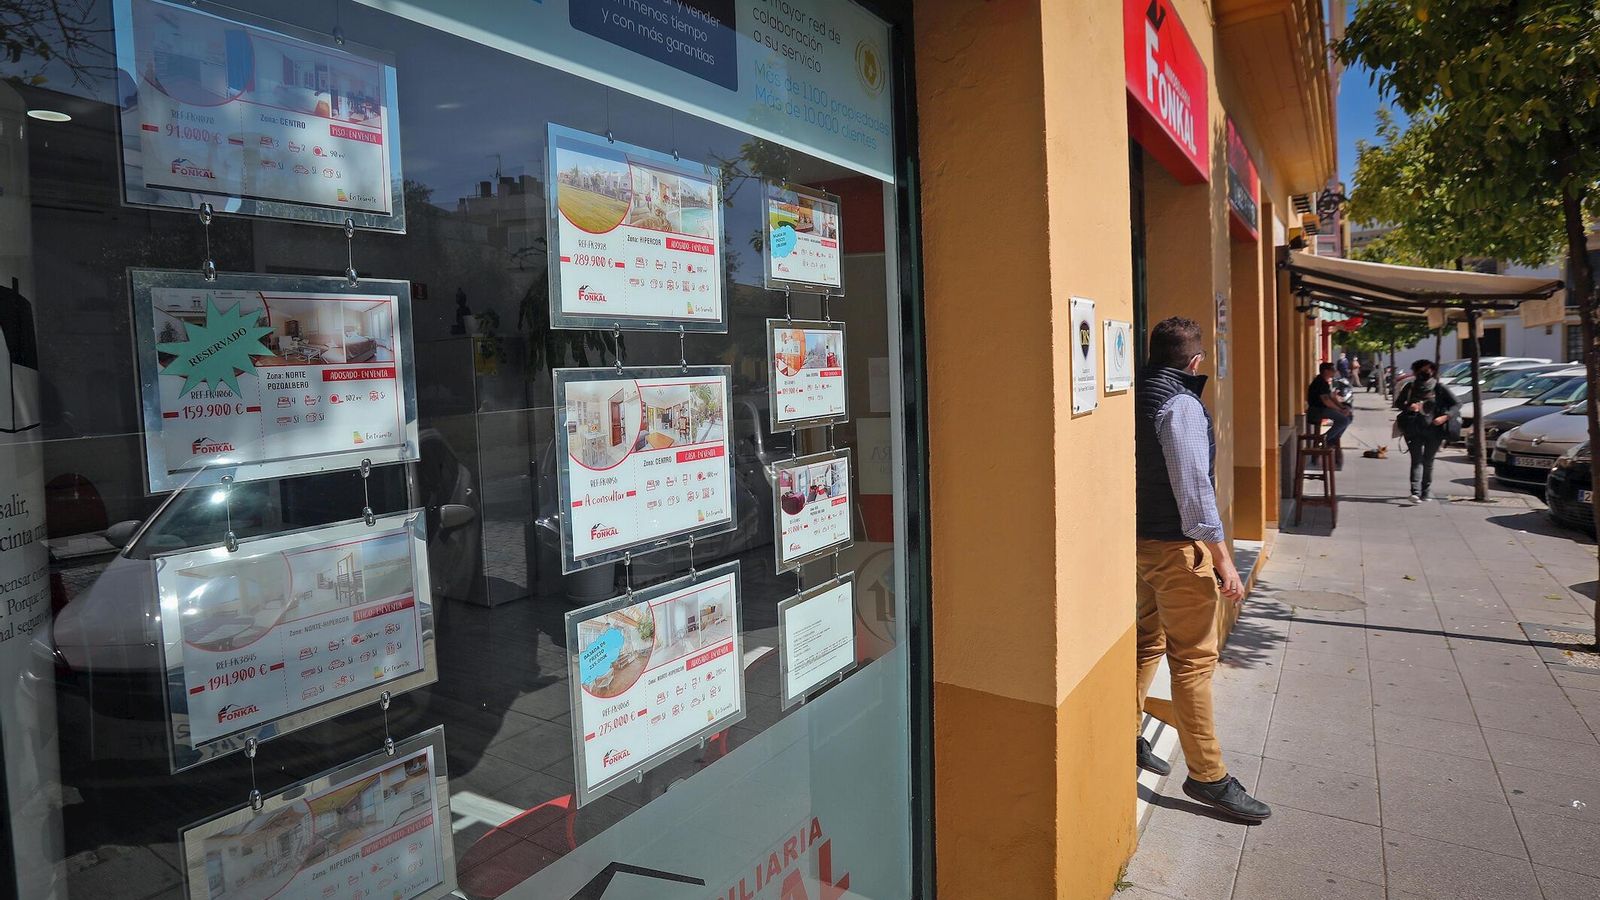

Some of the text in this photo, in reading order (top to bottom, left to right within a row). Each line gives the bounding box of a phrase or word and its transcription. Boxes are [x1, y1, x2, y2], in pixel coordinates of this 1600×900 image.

[601, 7, 609, 23] y
[612, 12, 635, 32] con
[638, 24, 664, 44] más
[685, 4, 721, 28] vender
[770, 0, 841, 45] mayor red de
[670, 15, 708, 42] tiempo
[752, 7, 824, 54] colaboración
[753, 30, 822, 73] a su servicio
[784, 75, 800, 95] de
[1145, 19, 1197, 157] FONKAL
[754, 83, 782, 111] Más
[785, 99, 801, 118] de
[841, 126, 878, 150] clientes
[171, 162, 216, 179] FONKAL
[573, 254, 607, 268] 289.900
[578, 289, 607, 302] FONKAL
[187, 327, 248, 368] RESERVADO
[267, 381, 309, 390] POZOALBERO
[285, 371, 306, 379] NORTE
[183, 402, 244, 420] 159.900 €
[192, 442, 236, 455] FONKAL
[591, 489, 625, 505] consultar
[0, 527, 33, 552] cinta
[591, 528, 619, 540] FONKAL
[208, 664, 268, 691] 194.900 €
[218, 706, 260, 723] FONKAL
[598, 714, 630, 736] 275.000
[603, 750, 631, 768] FONKAL
[717, 816, 823, 900] ILIARIA
